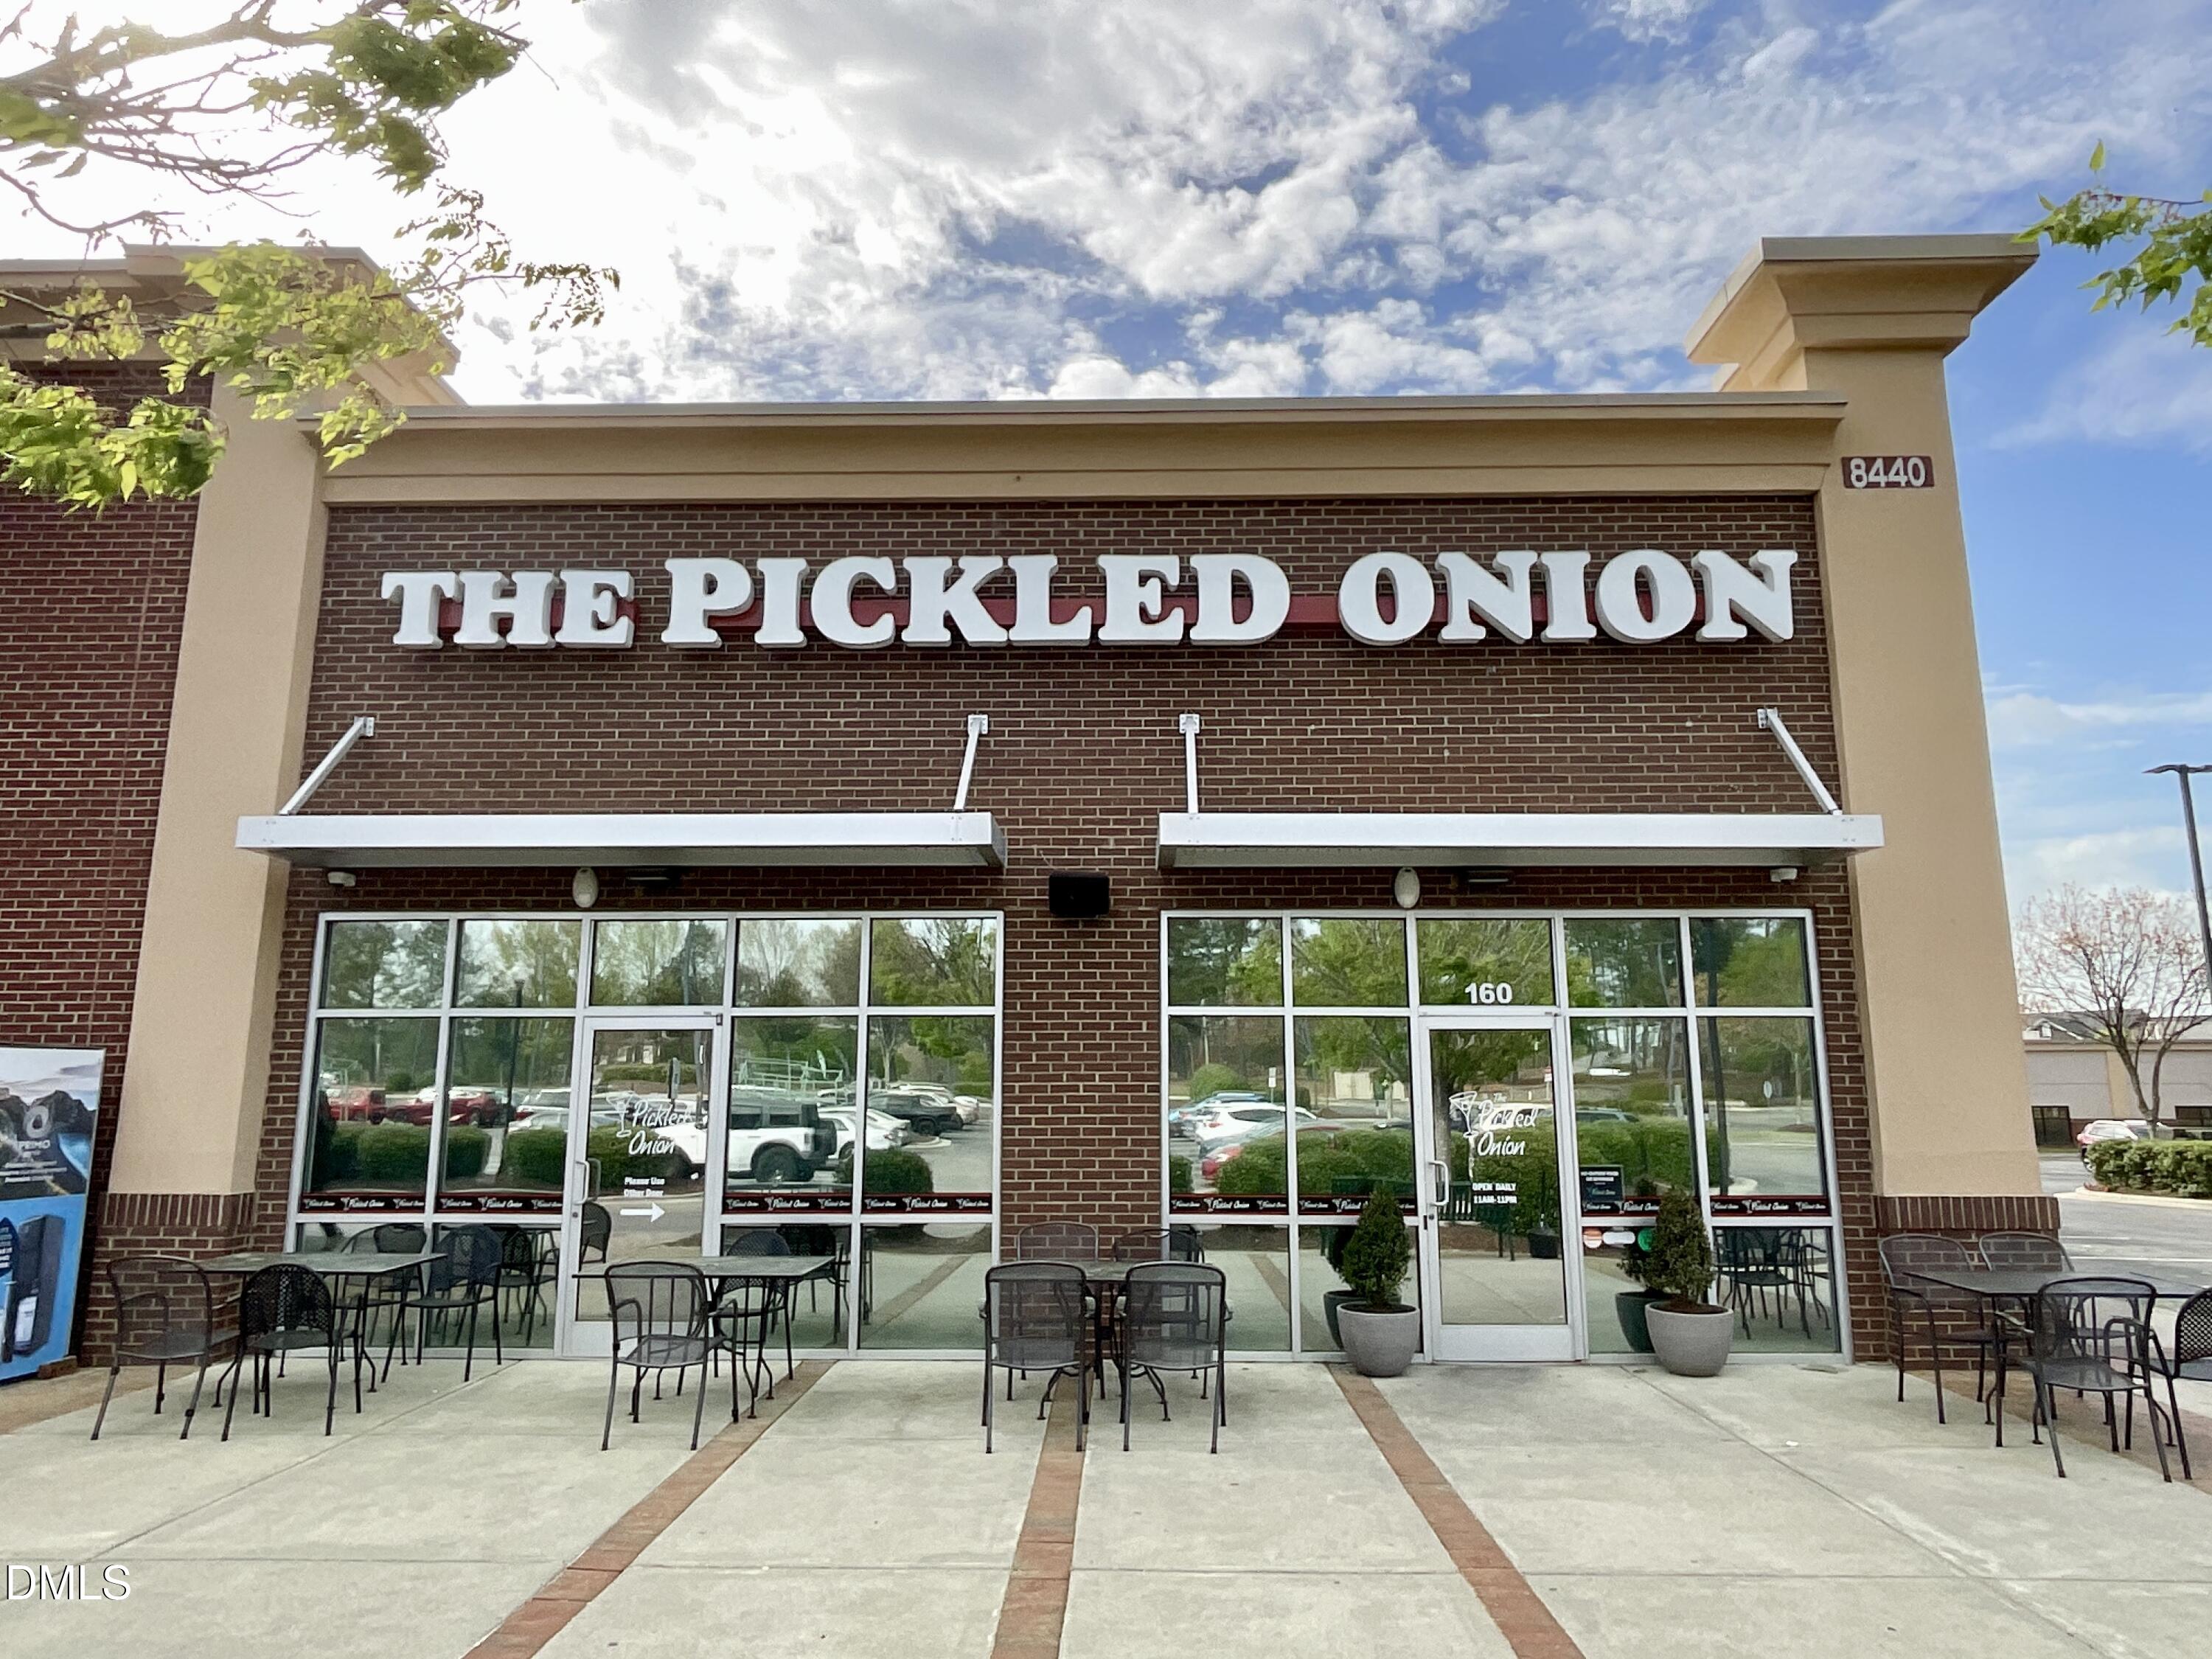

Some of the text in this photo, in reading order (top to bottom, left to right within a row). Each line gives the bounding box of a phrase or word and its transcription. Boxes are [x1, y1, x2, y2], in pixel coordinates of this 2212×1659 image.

[1849, 456, 1926, 488] 8440
[380, 549, 1798, 649] THE PICKLED ONION
[1464, 981, 1513, 1004] 160
[1478, 1099, 1539, 1129] Pcked
[628, 1130, 675, 1155] Onion
[1477, 1131, 1526, 1156] Onion
[1472, 1183, 1517, 1192] OPEN DAILY
